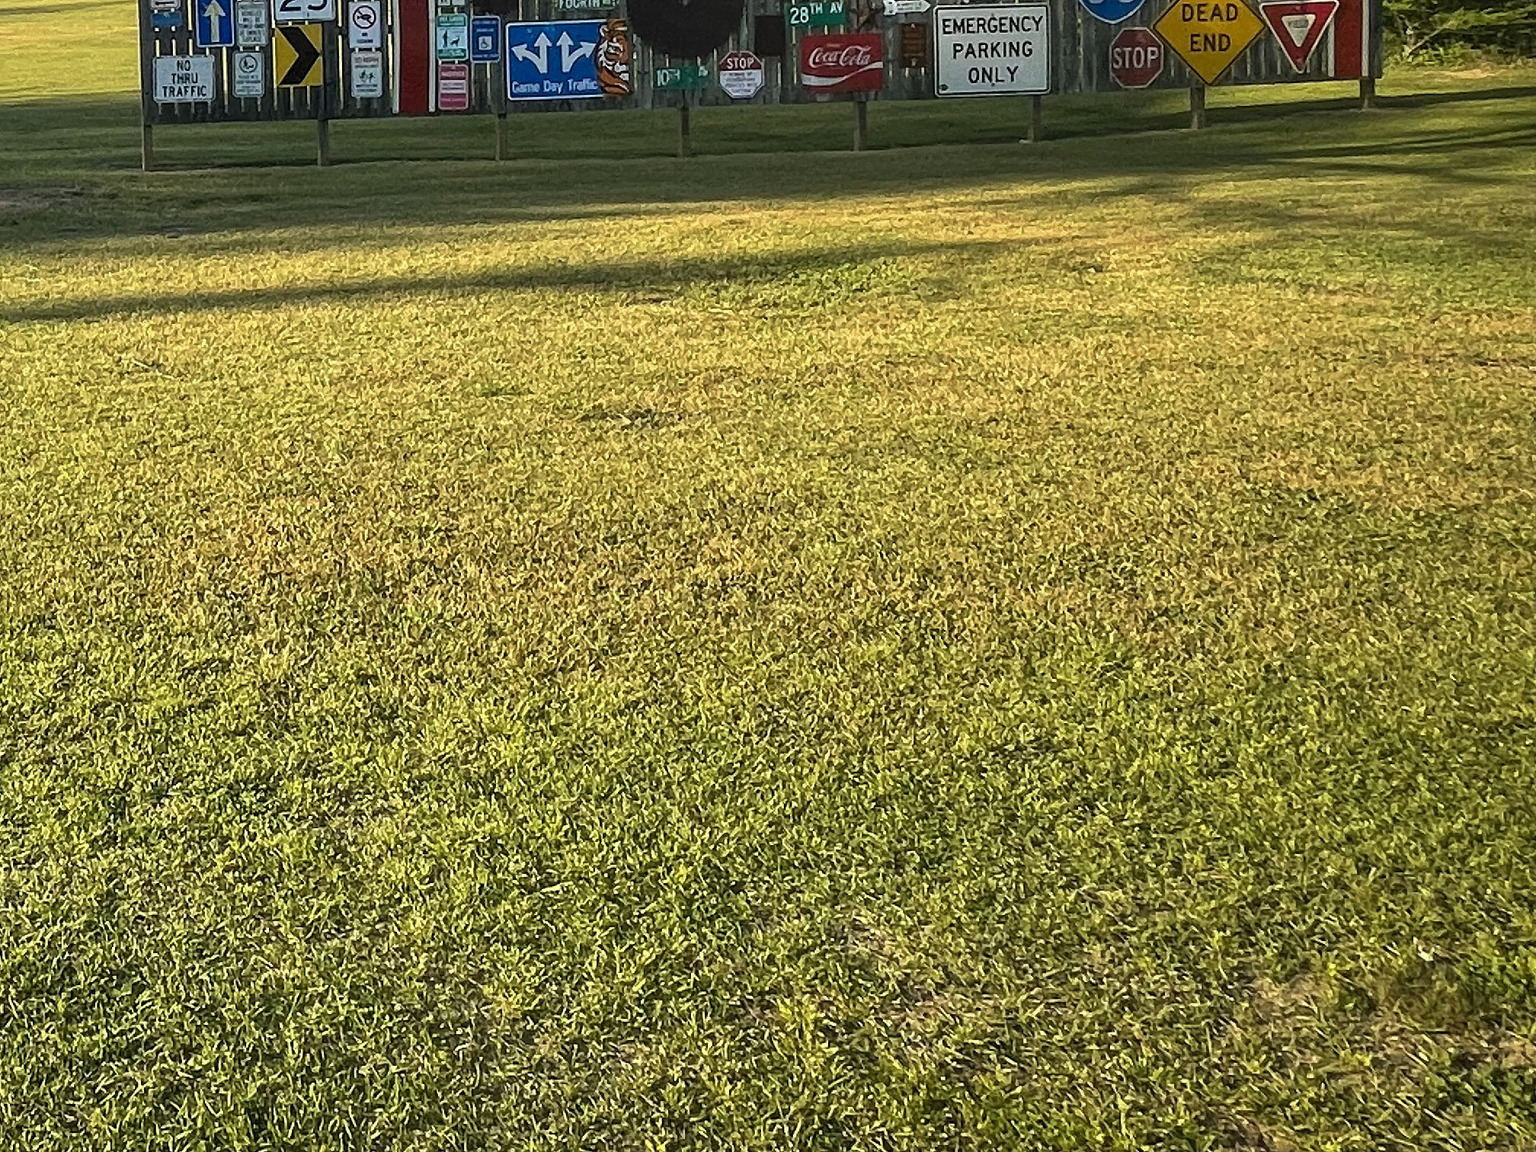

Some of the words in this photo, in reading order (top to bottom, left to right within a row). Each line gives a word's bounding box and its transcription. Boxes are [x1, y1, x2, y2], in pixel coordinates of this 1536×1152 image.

[789, 1, 823, 25] 28TH
[829, 1, 843, 14] AV
[1182, 2, 1239, 22] DEAD
[942, 15, 1043, 35] EMERGENCY
[953, 41, 1033, 60] PARKING
[1190, 33, 1232, 52] END
[176, 59, 191, 71] NO
[727, 57, 754, 69] STOP
[1113, 46, 1159, 69] STOP
[171, 72, 198, 85] THRU
[968, 65, 1019, 84] ONLY
[161, 85, 207, 97] TRAFFIC
[511, 80, 540, 94] Game
[543, 79, 564, 94] Day
[567, 77, 599, 92] Traffic
